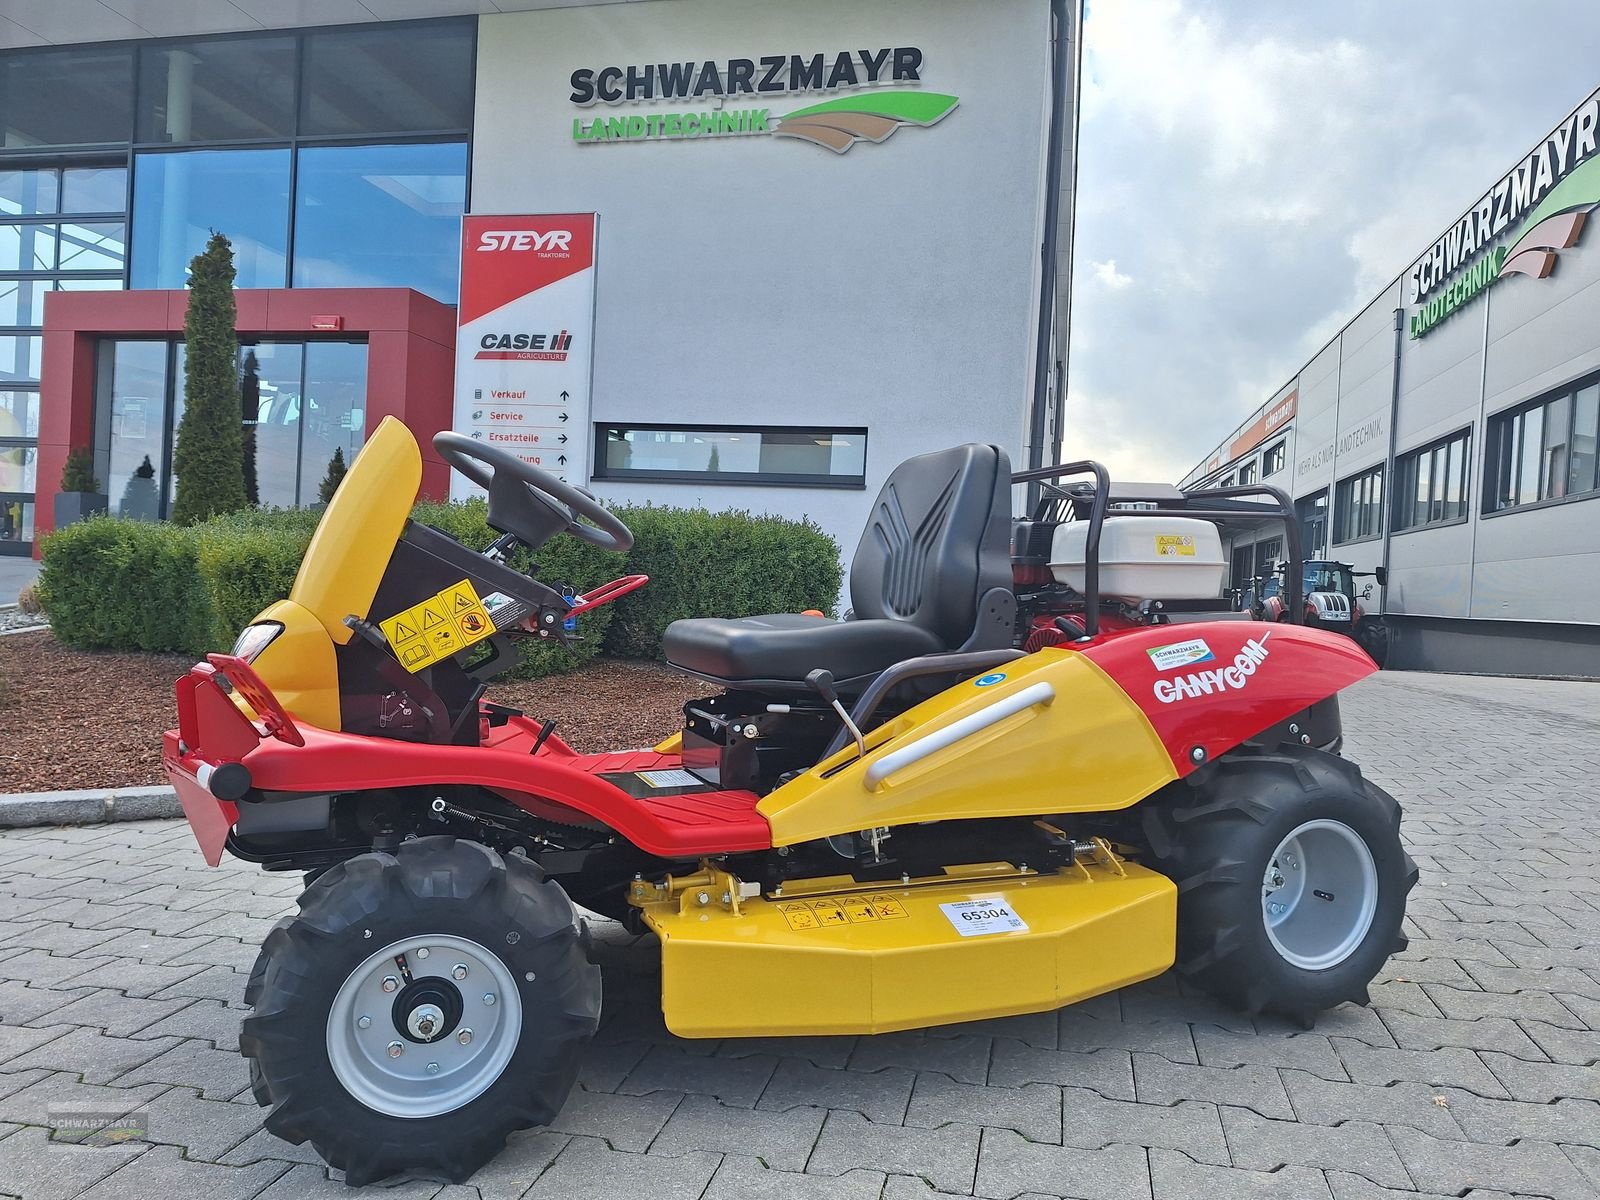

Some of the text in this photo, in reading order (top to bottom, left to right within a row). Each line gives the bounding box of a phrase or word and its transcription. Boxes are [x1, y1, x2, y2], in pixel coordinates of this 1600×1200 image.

[569, 46, 923, 103] SCHWARZMAYR
[572, 109, 770, 141] LANDTECHNIK
[1409, 99, 1600, 305] SCHWARZMAYR
[476, 230, 572, 251] STEYR
[1409, 247, 1503, 340] LANDTECHNIK
[480, 333, 547, 350] CASE
[517, 352, 565, 361] AGRICULTURE
[491, 390, 526, 399] Verkauf
[489, 411, 524, 421] Service
[489, 432, 539, 443] Ersatzteile
[1155, 644, 1200, 658] SCHWARZMAYR
[1153, 630, 1271, 704] CANYCOM
[961, 908, 1009, 921] 65304
